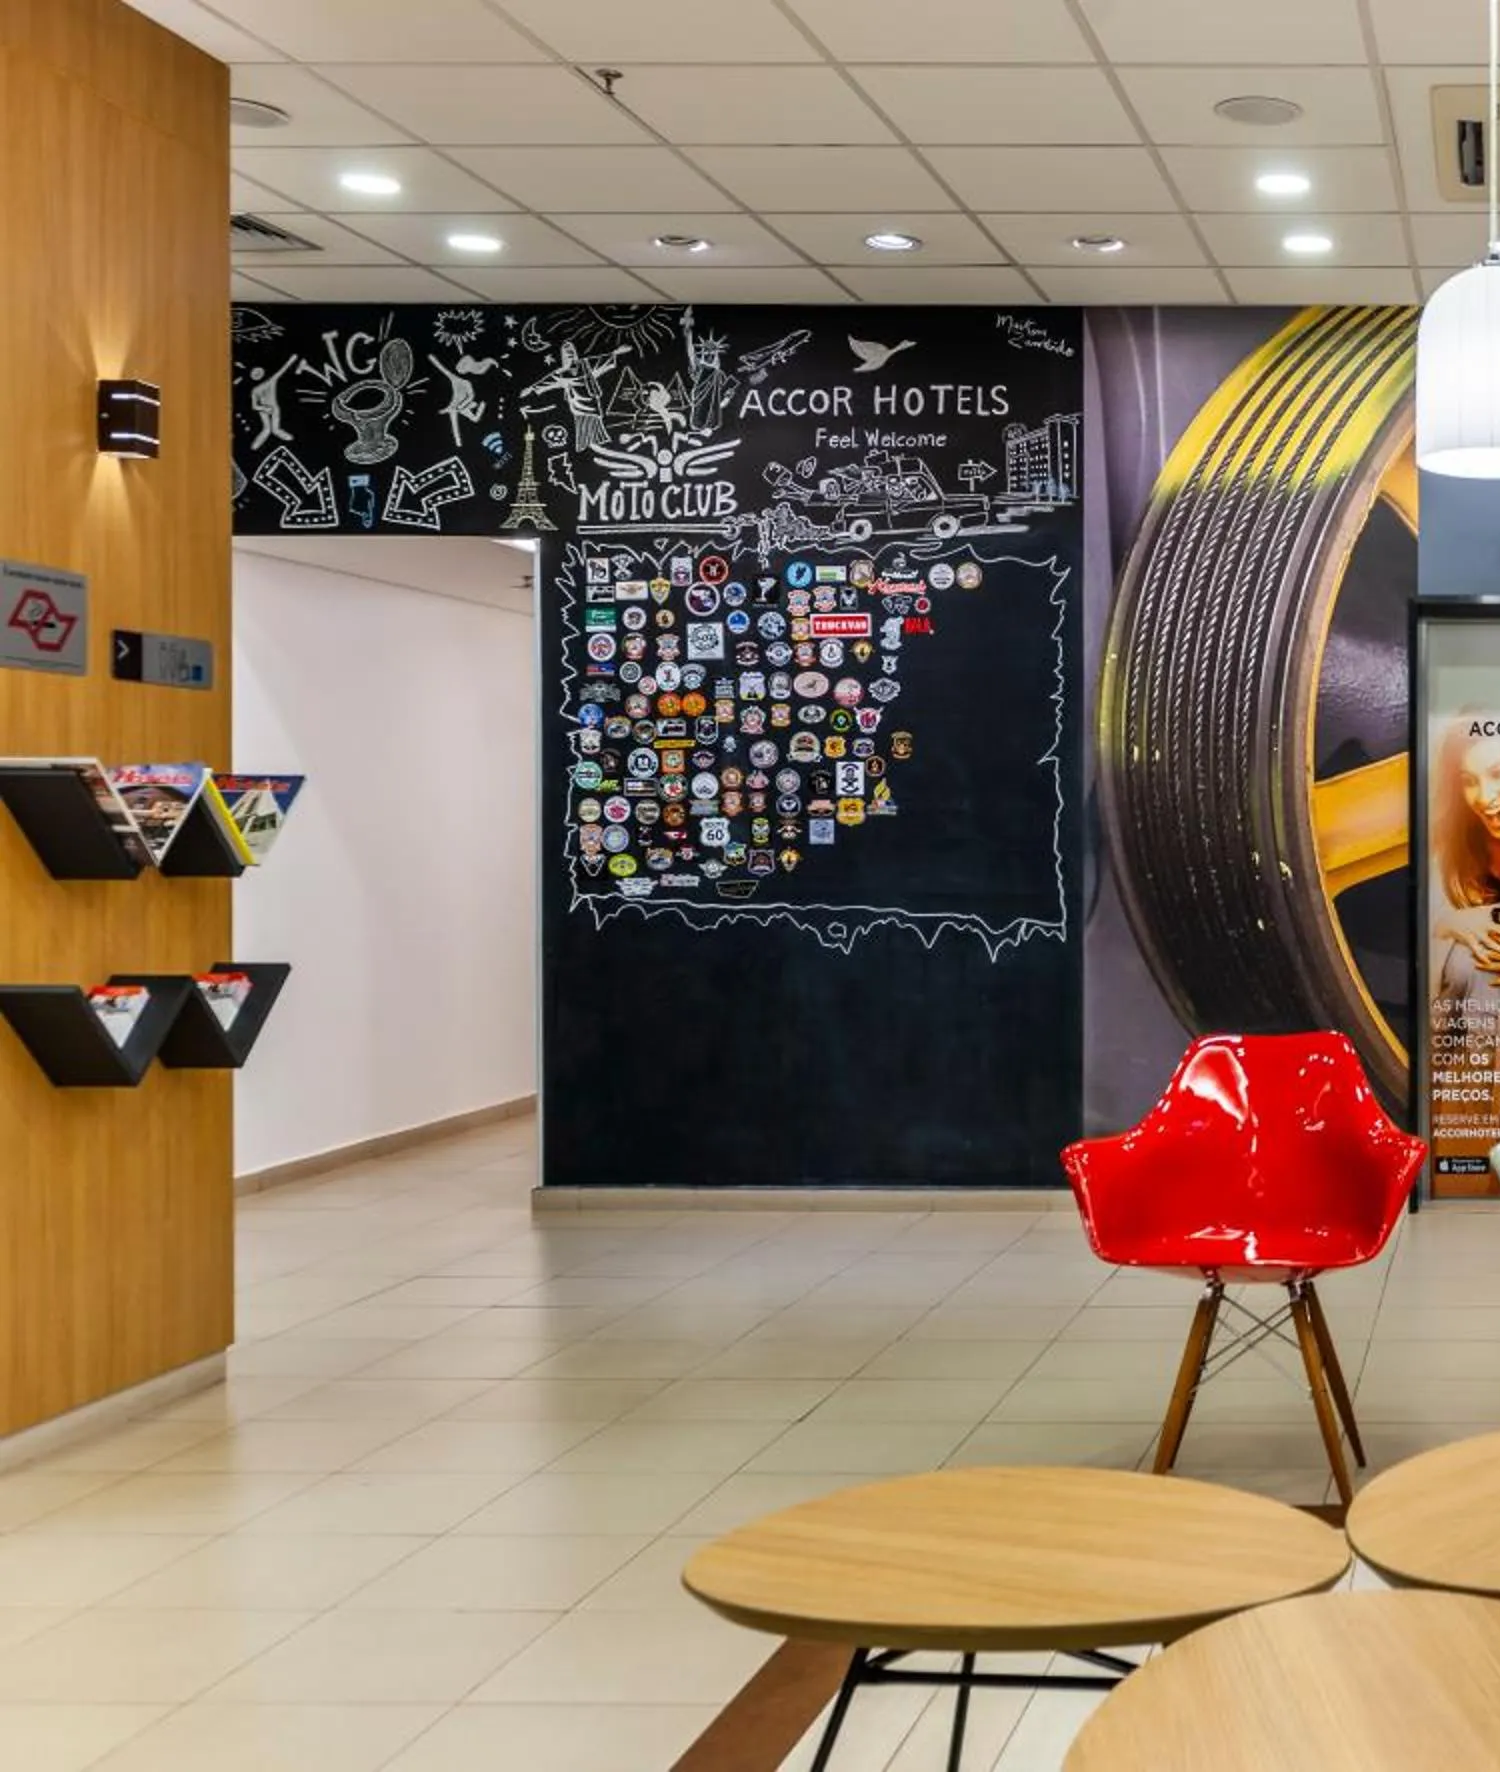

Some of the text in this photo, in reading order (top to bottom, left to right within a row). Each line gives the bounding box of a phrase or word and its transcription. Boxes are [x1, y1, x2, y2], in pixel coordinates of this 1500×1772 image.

[296, 331, 378, 387] WC
[739, 384, 1009, 418] ACCOR HOTELS
[815, 427, 947, 449] Feel Welcome
[577, 480, 739, 522] MOTO CLUB
[1433, 999, 1451, 1013] AS
[1433, 1016, 1495, 1030] VIAGENS
[1433, 1053, 1490, 1066] COM OS
[1432, 1088, 1495, 1103] PREÇOS.
